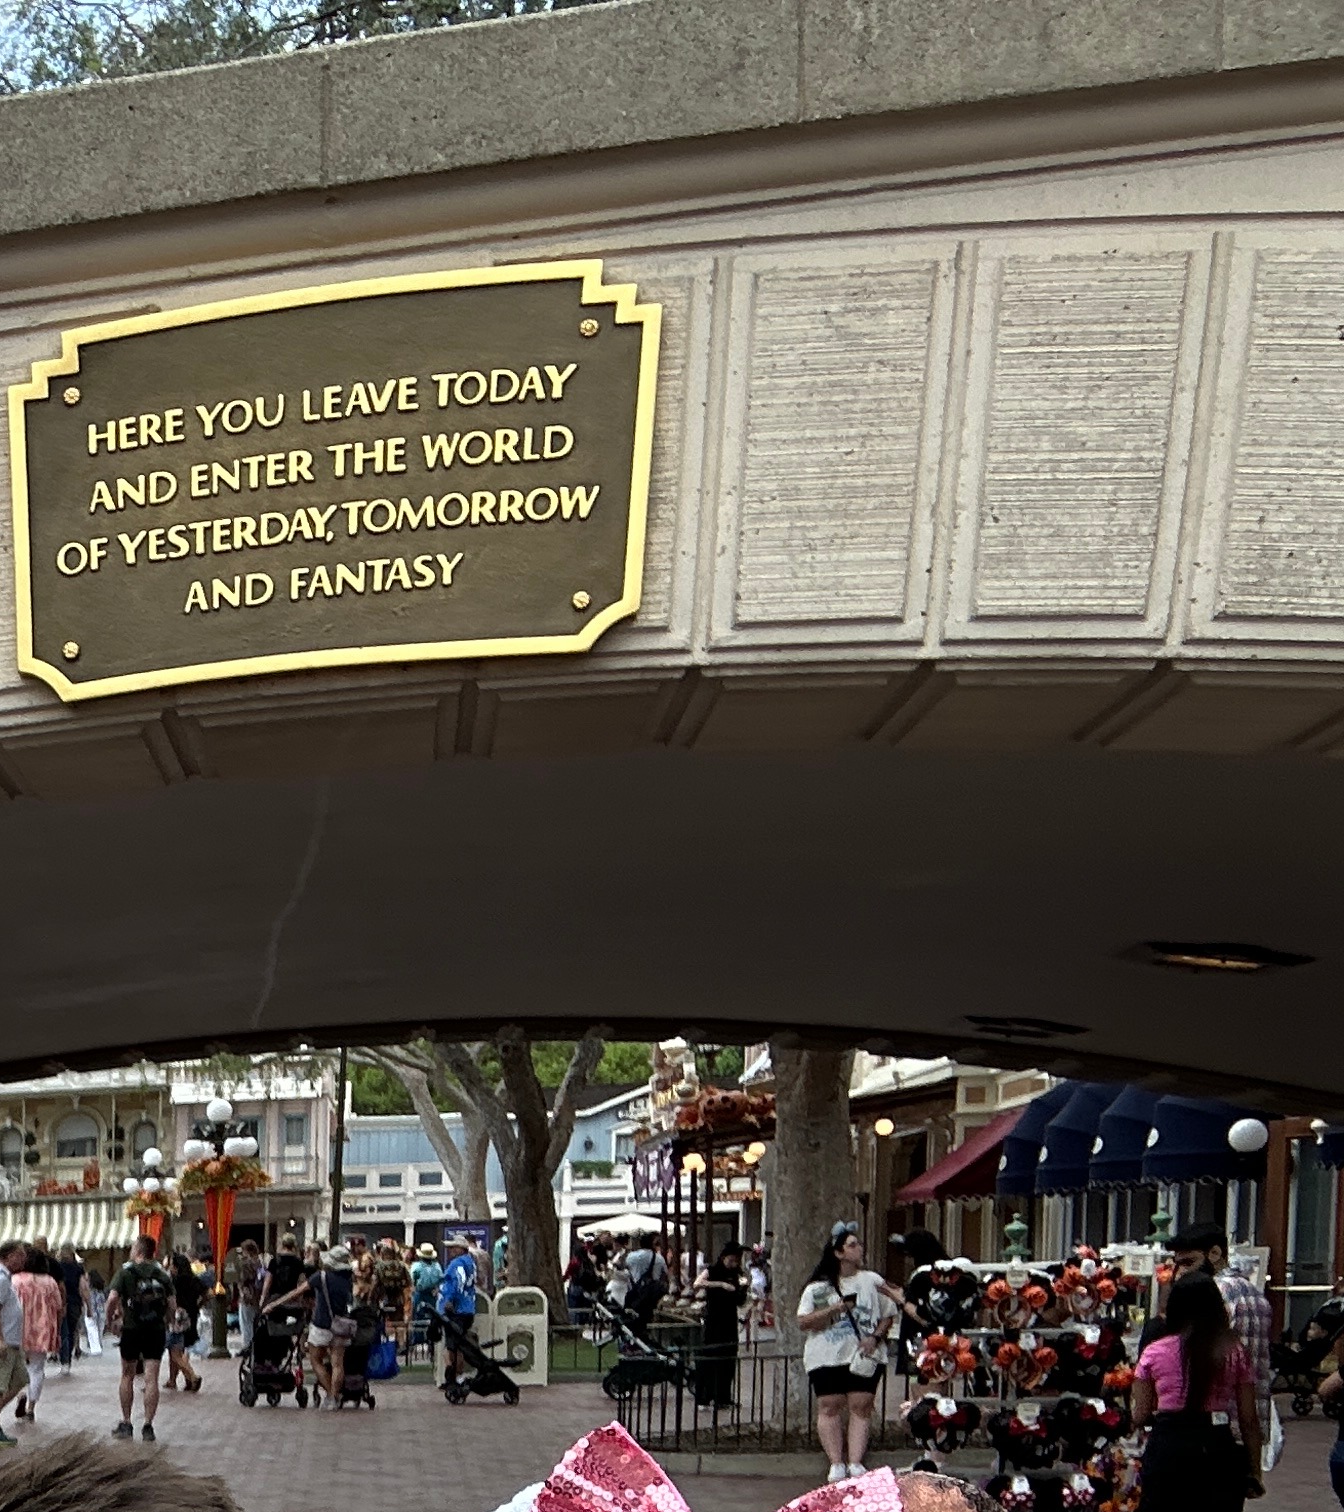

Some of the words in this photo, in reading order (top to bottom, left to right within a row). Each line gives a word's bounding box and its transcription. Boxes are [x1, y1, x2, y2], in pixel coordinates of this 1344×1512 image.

[88, 408, 186, 454] HERE
[195, 393, 285, 436] YOU
[302, 376, 420, 421] LEAVE
[431, 363, 578, 407] TODAY
[89, 471, 177, 513] AND
[190, 450, 315, 497] ENTER
[326, 437, 407, 477] THE
[421, 425, 574, 468] WORLD
[56, 537, 109, 575] OF
[117, 504, 338, 564] YESTERDAY,
[340, 485, 600, 535] TOMORROW
[184, 572, 274, 613] AND
[290, 552, 464, 600] FANTASY
